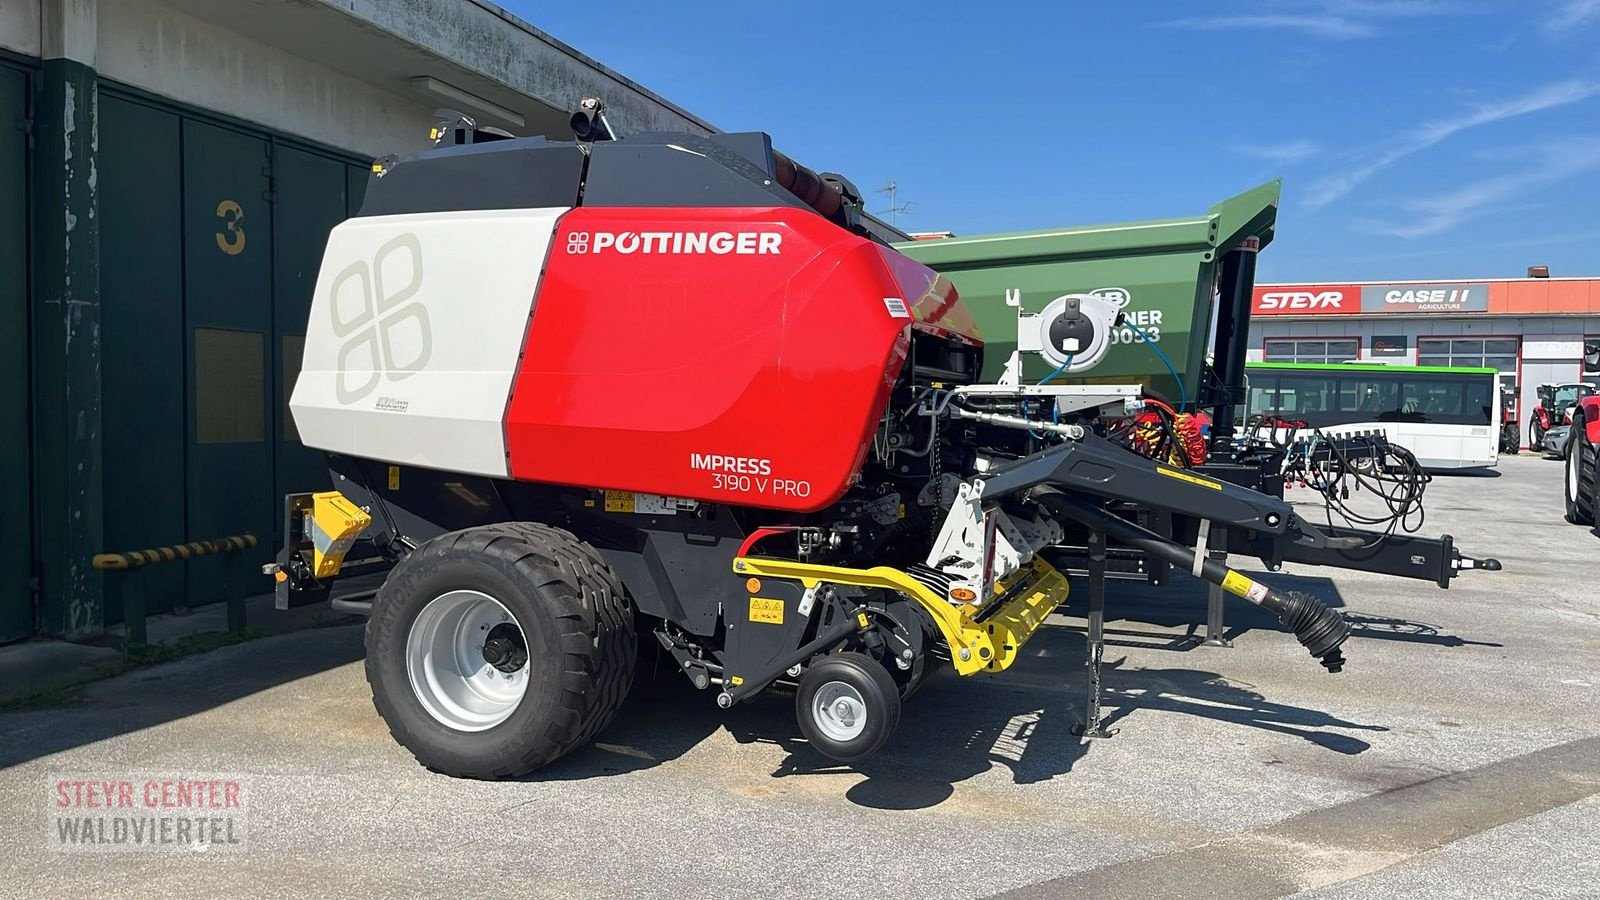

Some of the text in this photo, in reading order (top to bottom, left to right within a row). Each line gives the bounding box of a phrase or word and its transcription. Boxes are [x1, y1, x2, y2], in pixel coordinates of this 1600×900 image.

[216, 200, 246, 255] 3
[593, 231, 783, 254] PÖTTINGER
[1258, 291, 1343, 309] STEYR
[1385, 290, 1446, 303] CASE
[690, 453, 771, 476] IMPRESS
[711, 473, 811, 497] 3190 V PRO
